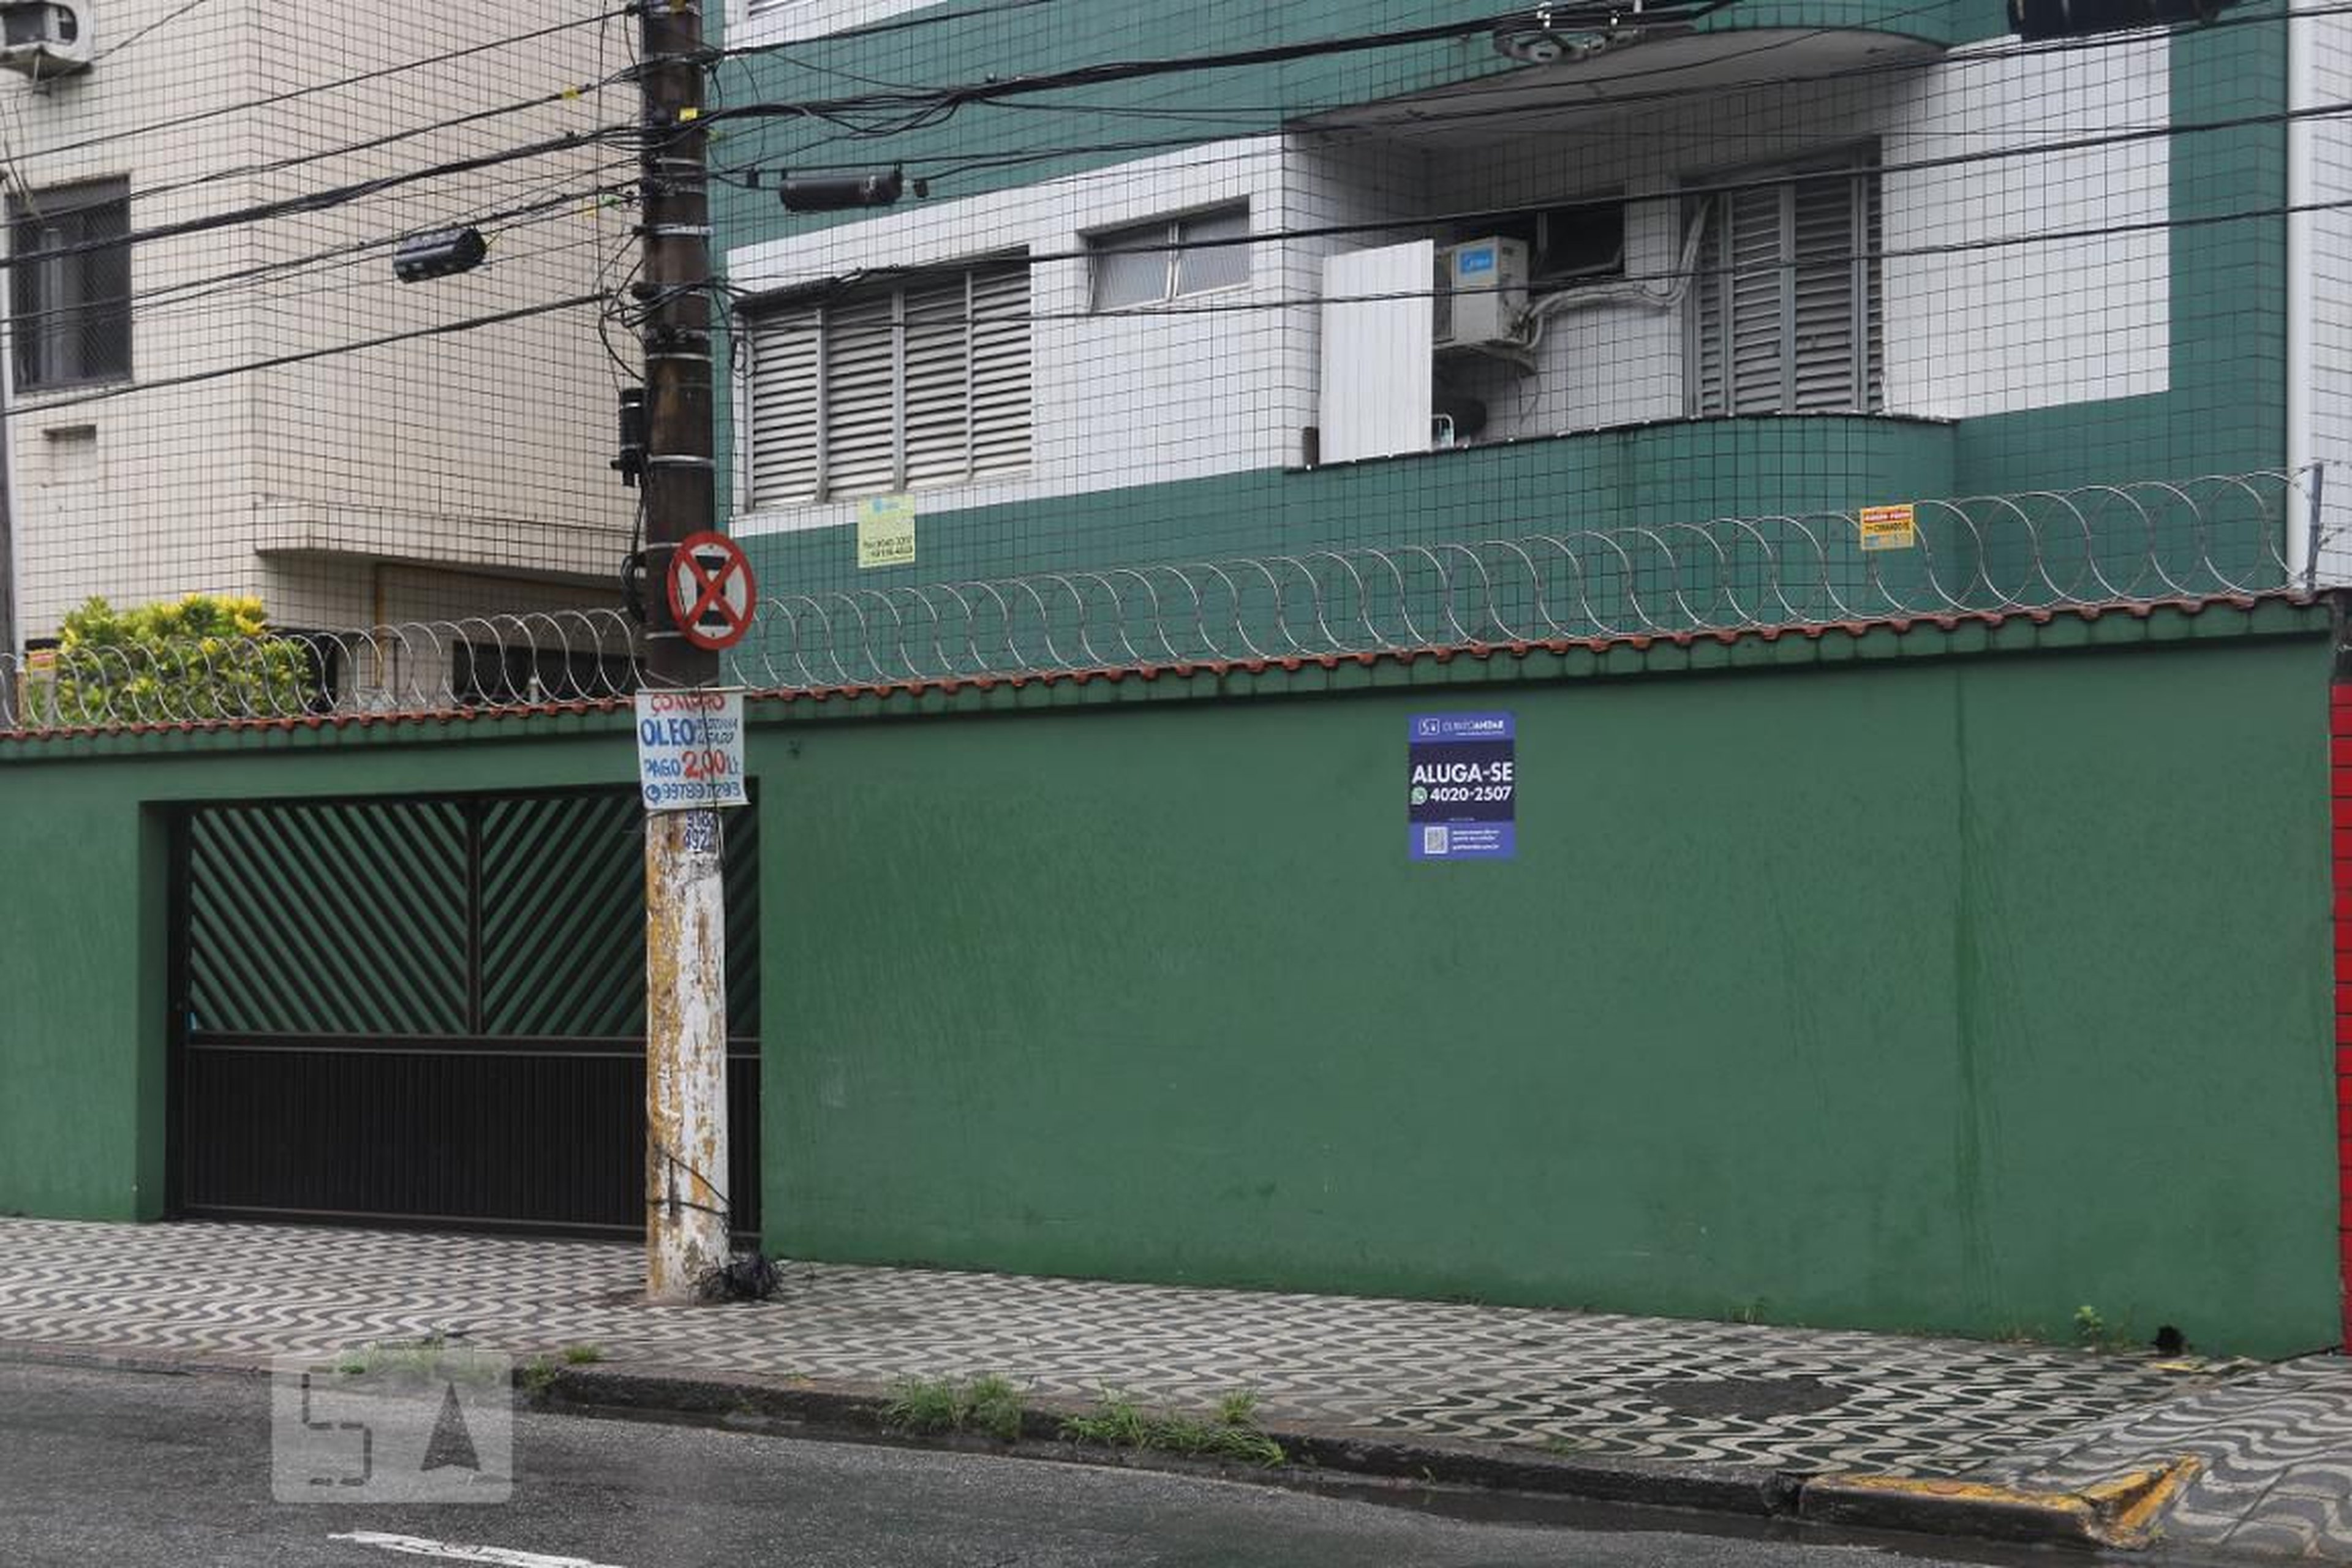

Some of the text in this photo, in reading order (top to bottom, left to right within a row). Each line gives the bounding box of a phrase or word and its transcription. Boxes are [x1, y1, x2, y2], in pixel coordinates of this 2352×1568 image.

[644, 758, 680, 777] PAGO
[682, 749, 726, 780] 2,00
[1412, 762, 1513, 783] ALUGA-SE
[1430, 786, 1512, 801] 4020-2507
